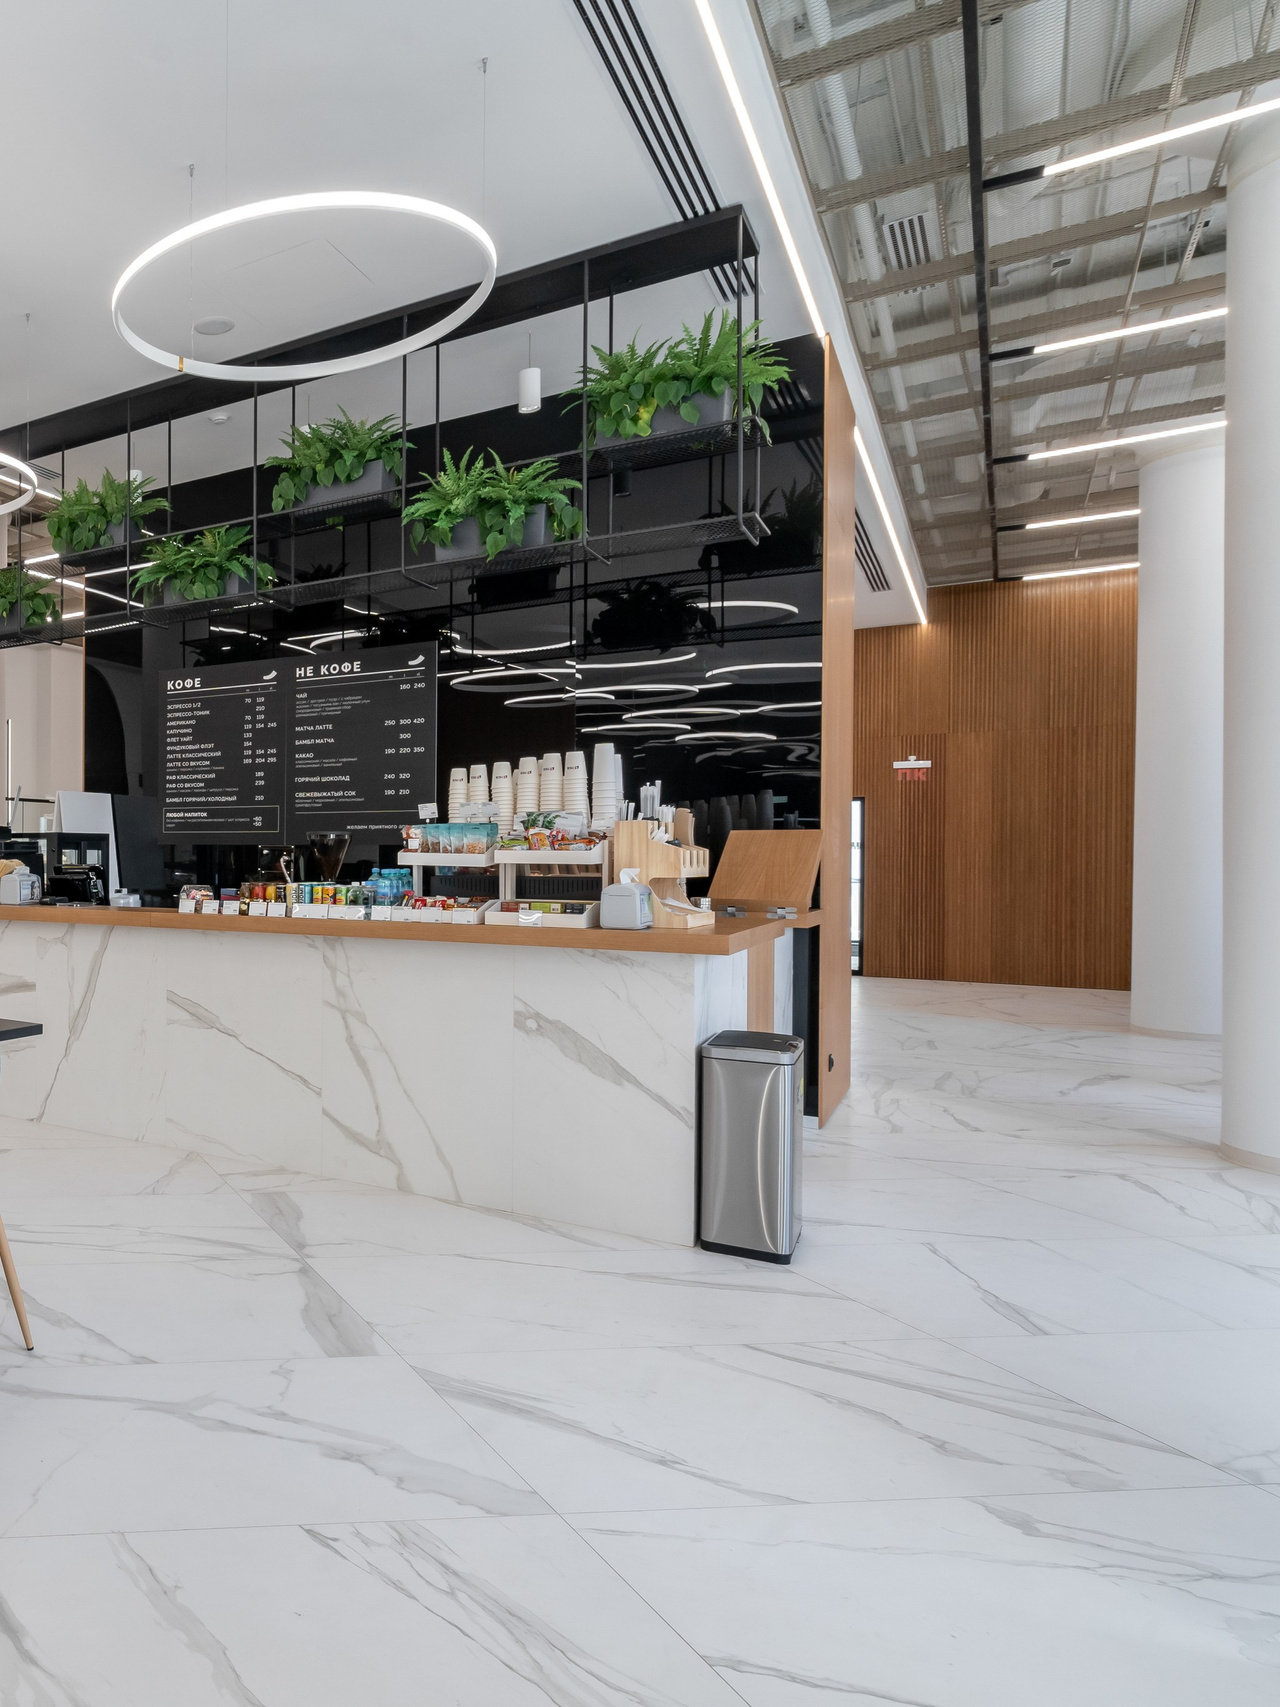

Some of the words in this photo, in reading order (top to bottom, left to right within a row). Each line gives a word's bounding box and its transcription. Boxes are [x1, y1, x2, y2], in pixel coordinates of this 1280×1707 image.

[296, 666, 314, 677] НЕ
[321, 661, 361, 675] КОФЕ
[167, 678, 201, 690] КОФЕ
[897, 768, 926, 781] ПК
